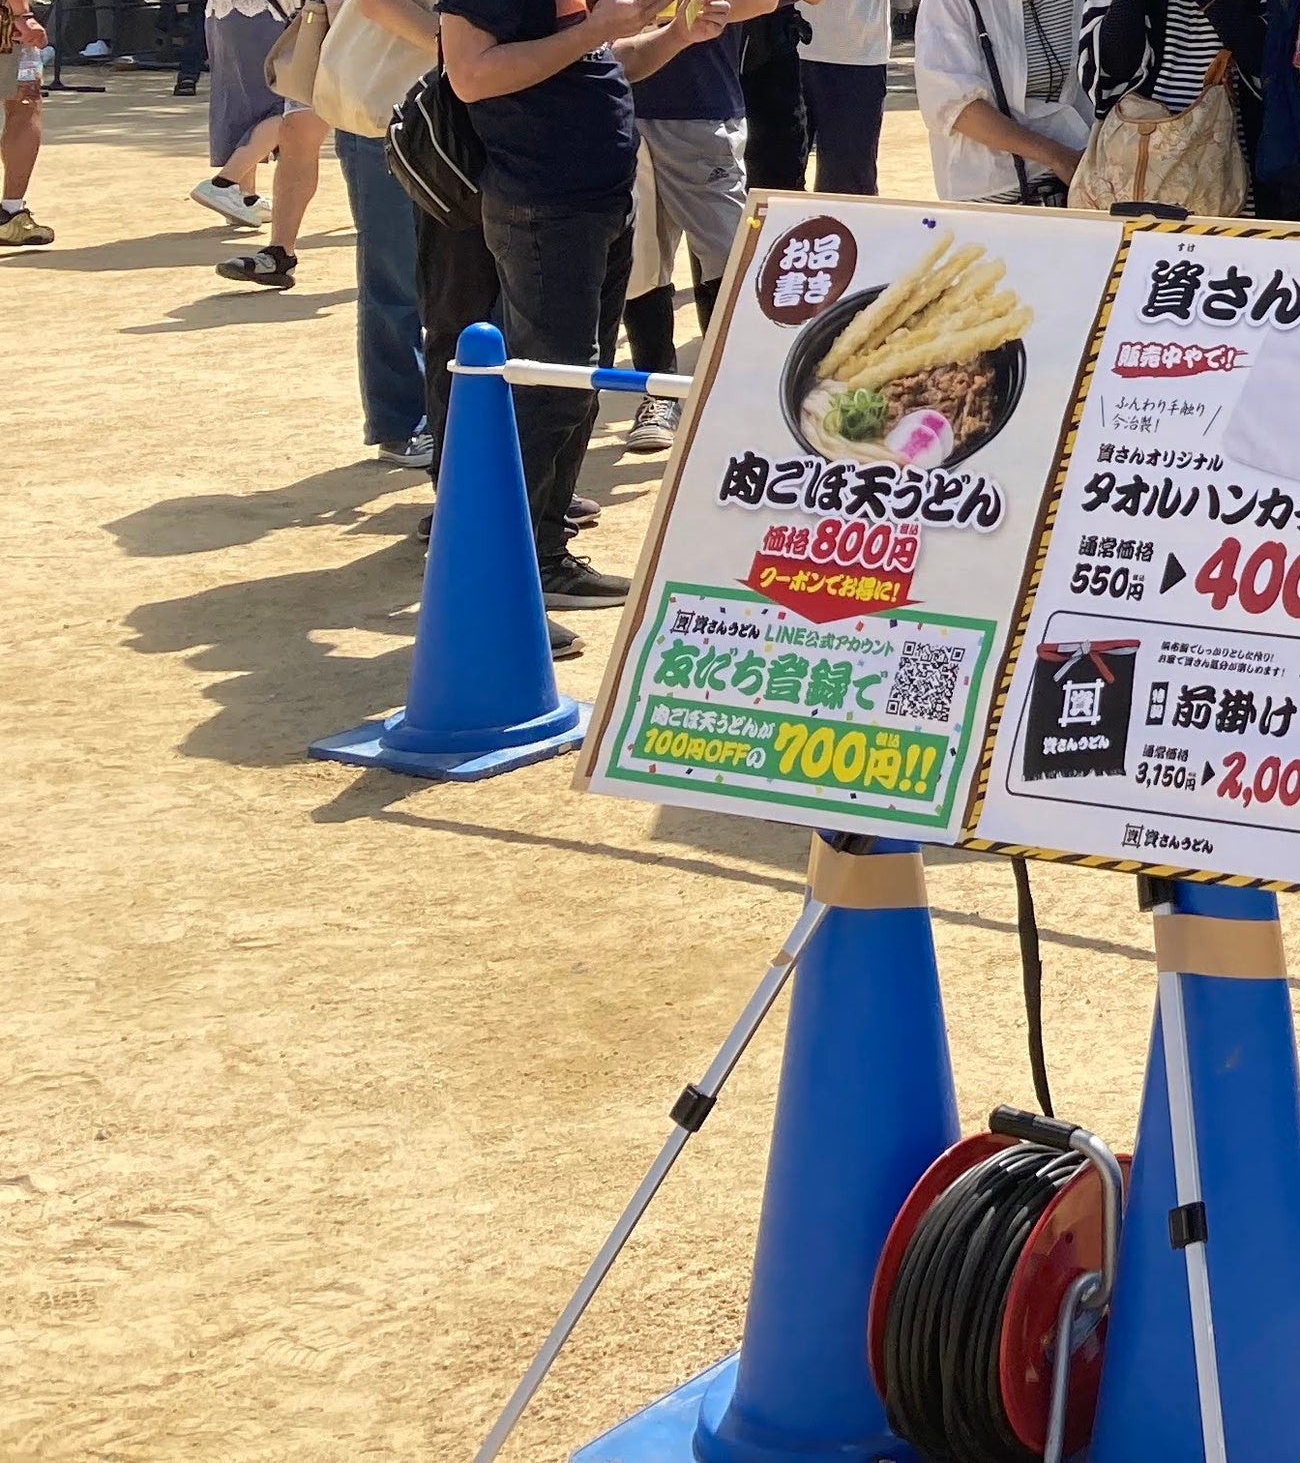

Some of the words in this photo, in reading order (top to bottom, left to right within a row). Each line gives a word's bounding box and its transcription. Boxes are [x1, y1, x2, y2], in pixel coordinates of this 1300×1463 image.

[779, 234, 841, 270] お品
[773, 270, 832, 308] 書き
[1118, 344, 1234, 369] 販売中やで!
[1115, 396, 1205, 418] ふんわり手触り
[1097, 443, 1223, 472] 資さんオリジナル
[719, 451, 1001, 527] 肉ごぼ天うどん
[763, 519, 918, 570] 価格800円
[1078, 535, 1154, 562] 通常価格
[760, 567, 900, 602] クーポンでお得に!
[1070, 563, 1144, 601] 550円
[693, 614, 760, 640] 資さんうどん
[765, 624, 894, 657] LINE公式アカウント
[654, 638, 887, 711] 友だち登録で
[650, 705, 774, 739] 肉ごぼ天うどんが
[1172, 685, 1297, 738] 前掛け
[643, 729, 766, 769] 100円OFFの
[774, 722, 937, 794] 700円!!
[1042, 735, 1110, 755] 資さんうどん
[1135, 761, 1197, 791] 3,150円
[1145, 827, 1214, 855] 資さんうどん
